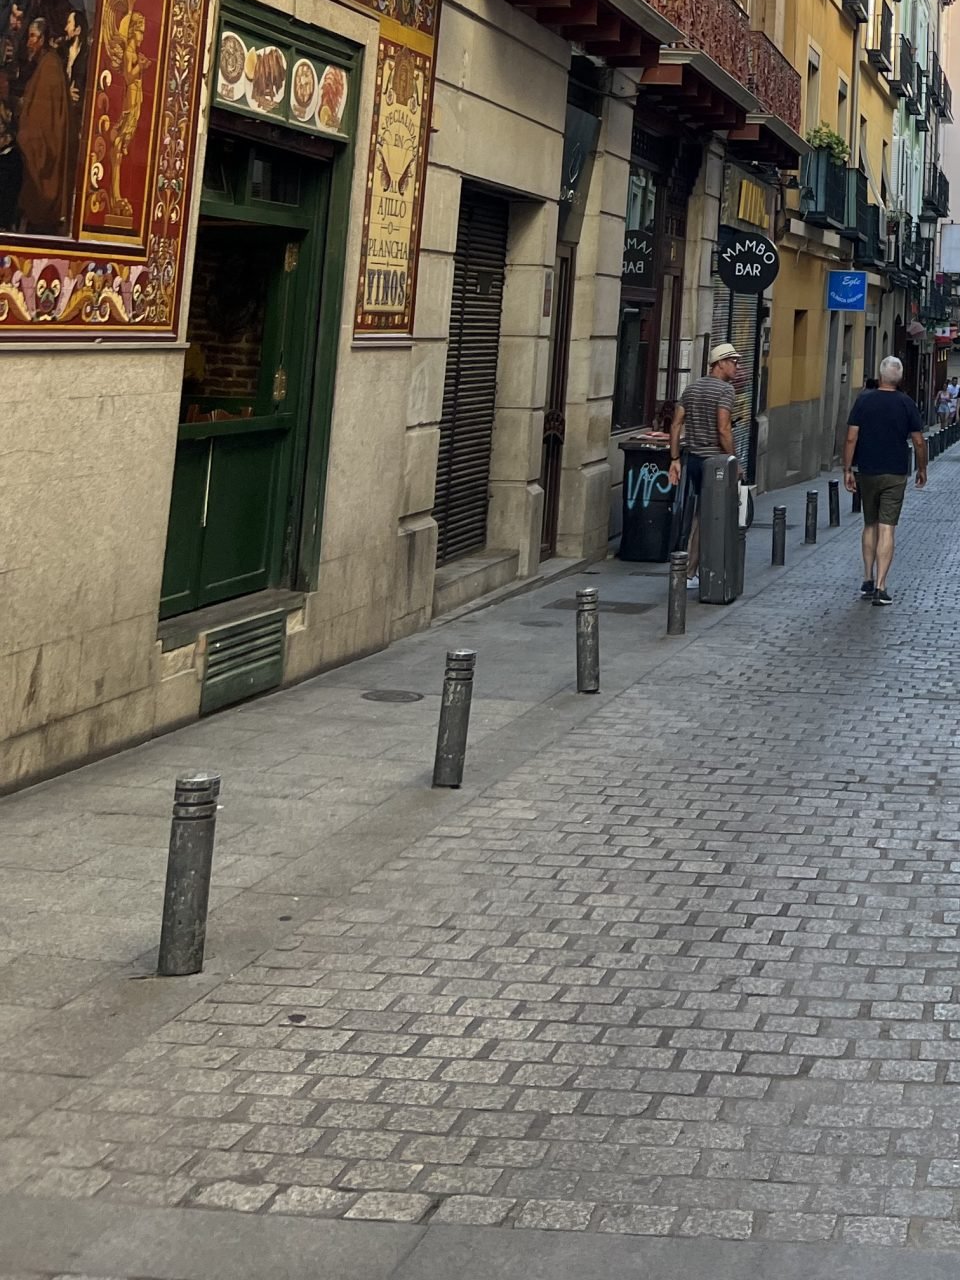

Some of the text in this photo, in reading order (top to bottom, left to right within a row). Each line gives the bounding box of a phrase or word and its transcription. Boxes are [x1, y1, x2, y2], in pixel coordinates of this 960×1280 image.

[394, 133, 404, 149] EN
[376, 196, 407, 221] AJILLO
[367, 238, 408, 260] PLANCHA
[722, 239, 775, 265] MAMBO
[735, 262, 762, 277] BAR
[366, 268, 406, 307] VINOS
